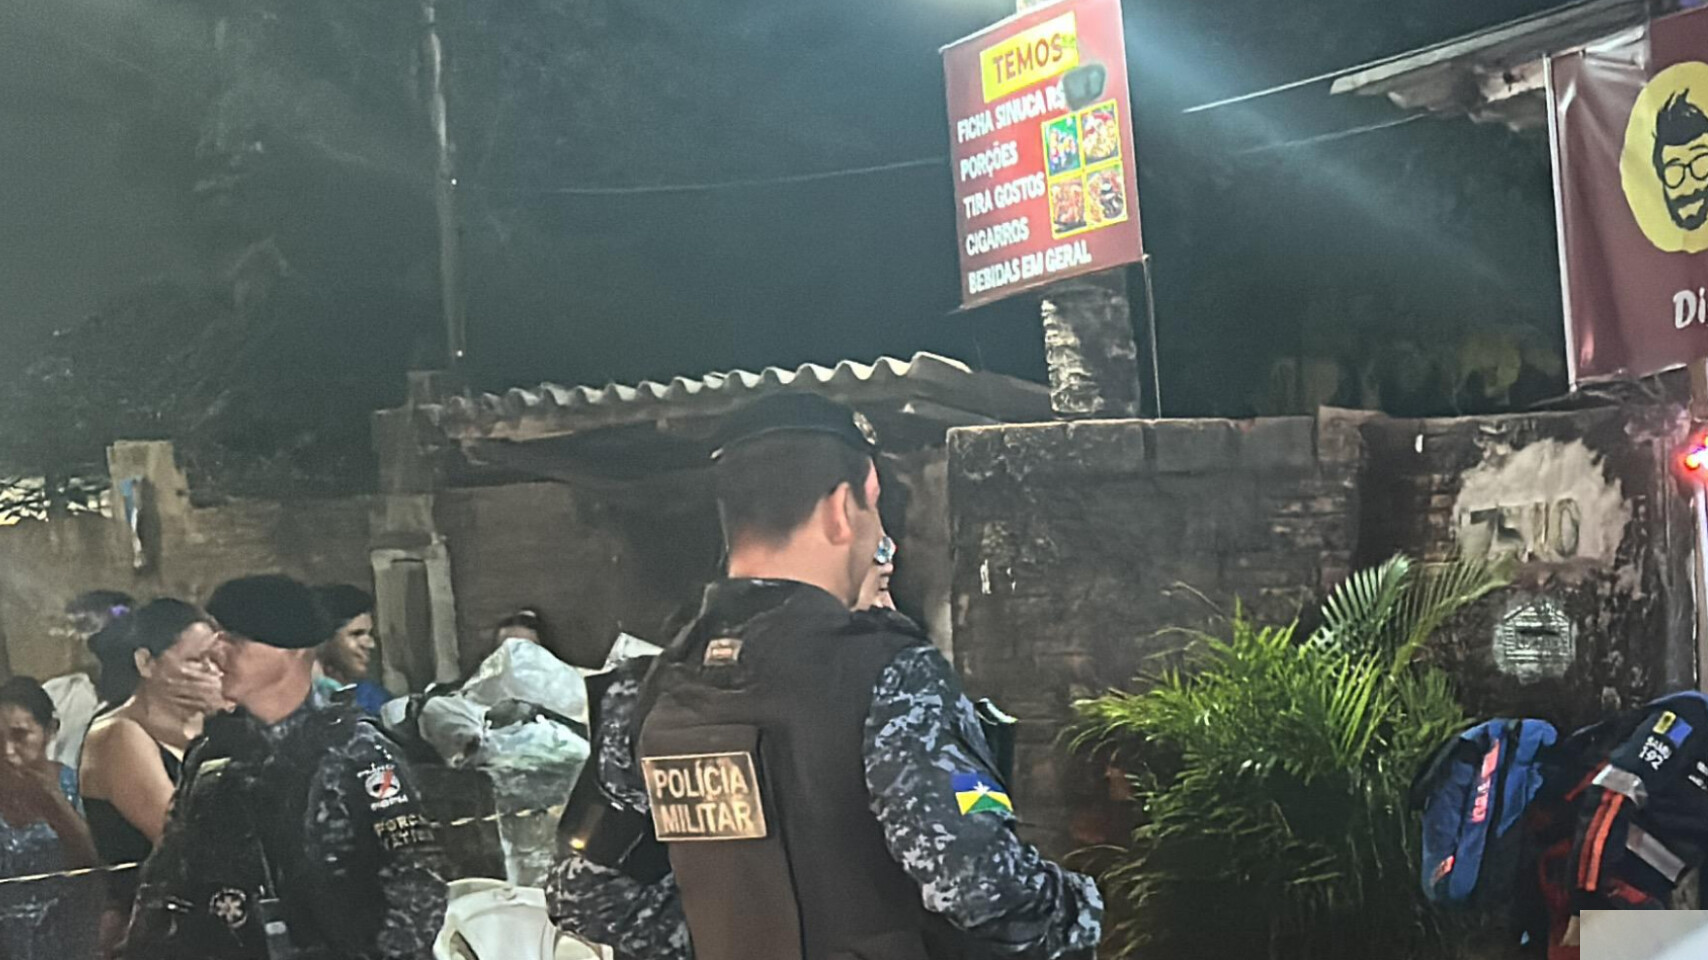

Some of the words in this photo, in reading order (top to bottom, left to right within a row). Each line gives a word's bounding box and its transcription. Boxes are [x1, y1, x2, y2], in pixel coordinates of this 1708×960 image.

[993, 33, 1063, 84] TEMOS
[957, 110, 995, 144] FICHA
[995, 88, 1047, 130] SINUCA
[960, 141, 1019, 182] PORÇÕES
[963, 189, 994, 219] TIRA
[994, 171, 1046, 208] GOSTOS
[966, 217, 1030, 256] CIGARROS
[968, 258, 1021, 294] BEBIDAS
[1021, 251, 1044, 279] EM
[1045, 240, 1092, 272] GERAL
[654, 760, 749, 799] POLÍCIA
[660, 800, 756, 833] MILITAR
